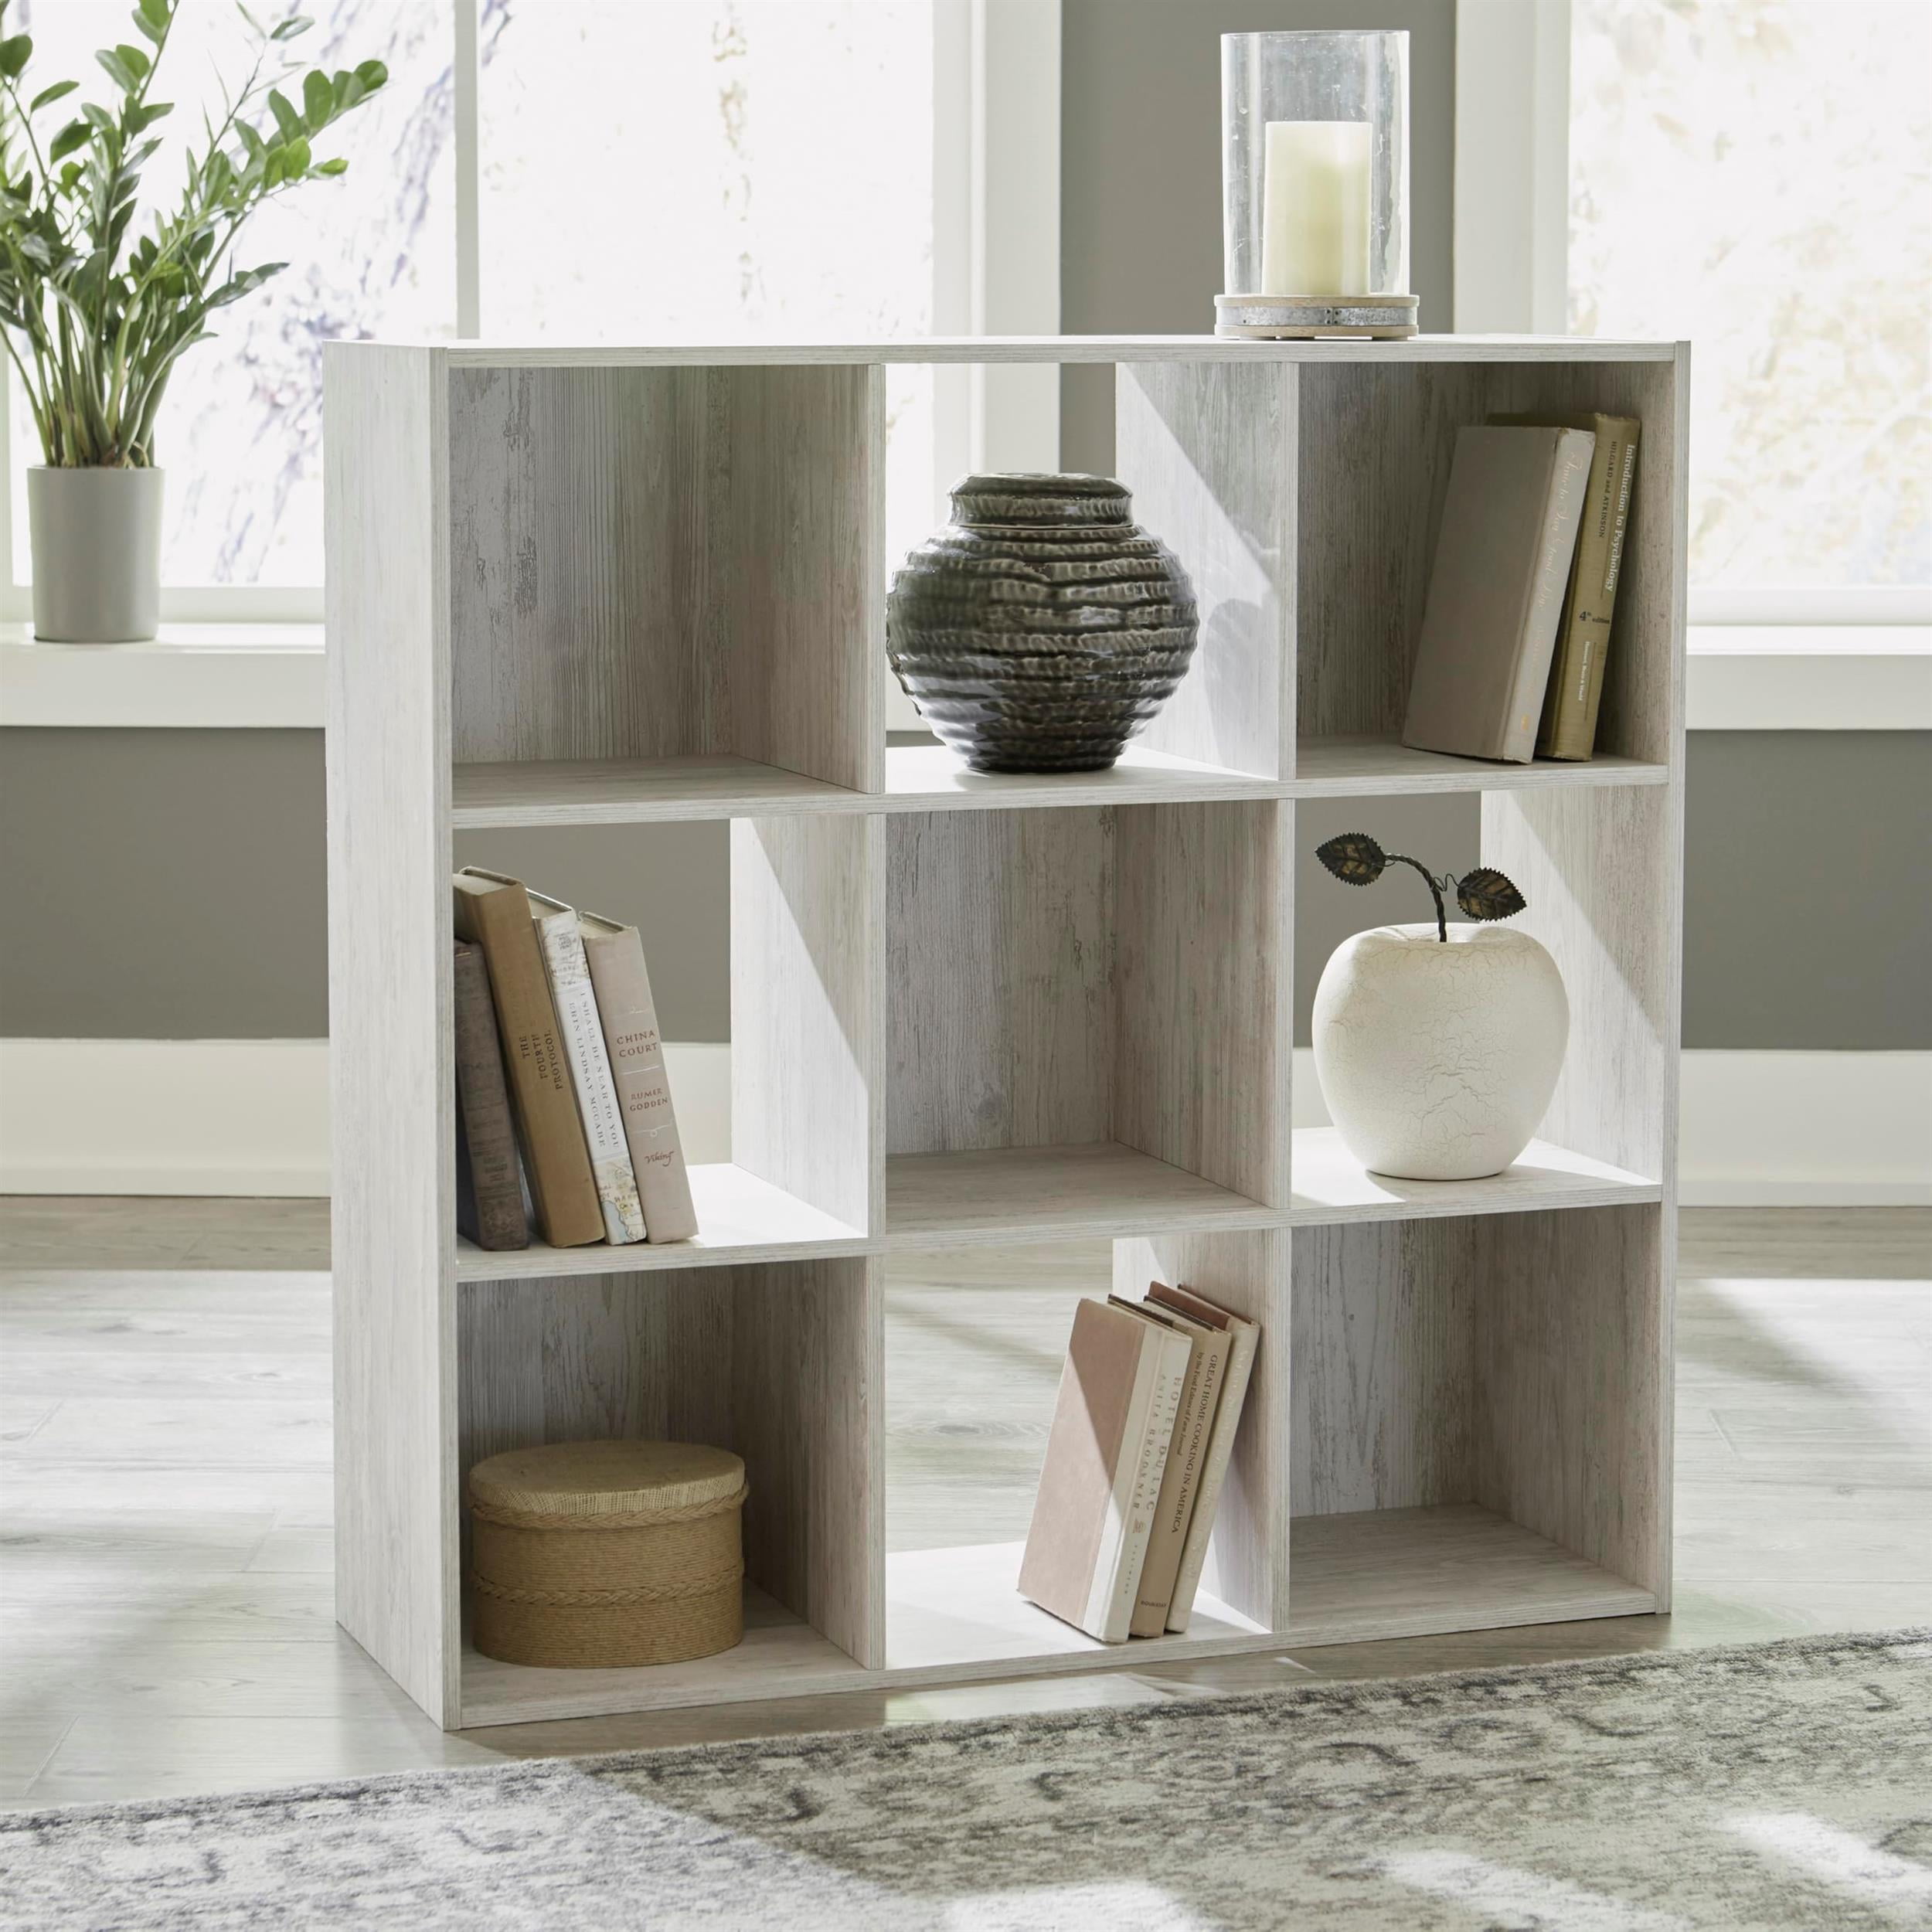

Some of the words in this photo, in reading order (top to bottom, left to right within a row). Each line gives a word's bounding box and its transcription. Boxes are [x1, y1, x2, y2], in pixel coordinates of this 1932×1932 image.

[1607, 440, 1617, 478] HILGARD
[1618, 444, 1635, 512] Introduction
[1599, 495, 1609, 538] ATKINSON
[1616, 515, 1624, 526] to
[1605, 529, 1623, 592] Psychology
[519, 1035, 530, 1059] THE
[531, 1033, 548, 1080] FOURTH
[569, 1002, 581, 1032] ERIN
[577, 1038, 594, 1090] LINDSAY
[617, 1030, 655, 1045] CHINA
[619, 1042, 658, 1057] COURT
[544, 1029, 563, 1090] PROTOCOL
[582, 1001, 595, 1041] SHALL
[592, 1046, 600, 1061] BE
[597, 1066, 608, 1099] NEAR
[605, 1104, 612, 1119] TO
[610, 1124, 619, 1148] YOU
[630, 1097, 668, 1112] GODDEN
[631, 1087, 663, 1100] RUMER
[644, 1151, 675, 1168] Viking
[1205, 1354, 1218, 1389] GREAT
[1154, 1374, 1166, 1417] ANITA
[1162, 1377, 1182, 1435] HOTEL
[1197, 1390, 1210, 1422] HOME
[1156, 1446, 1167, 1468] DU
[1186, 1423, 1202, 1471] COOKING
[1133, 1429, 1155, 1509] BROOKNER
[1183, 1473, 1192, 1485] IN
[1146, 1477, 1160, 1510] LAC
[1172, 1486, 1188, 1533] AMERICA
